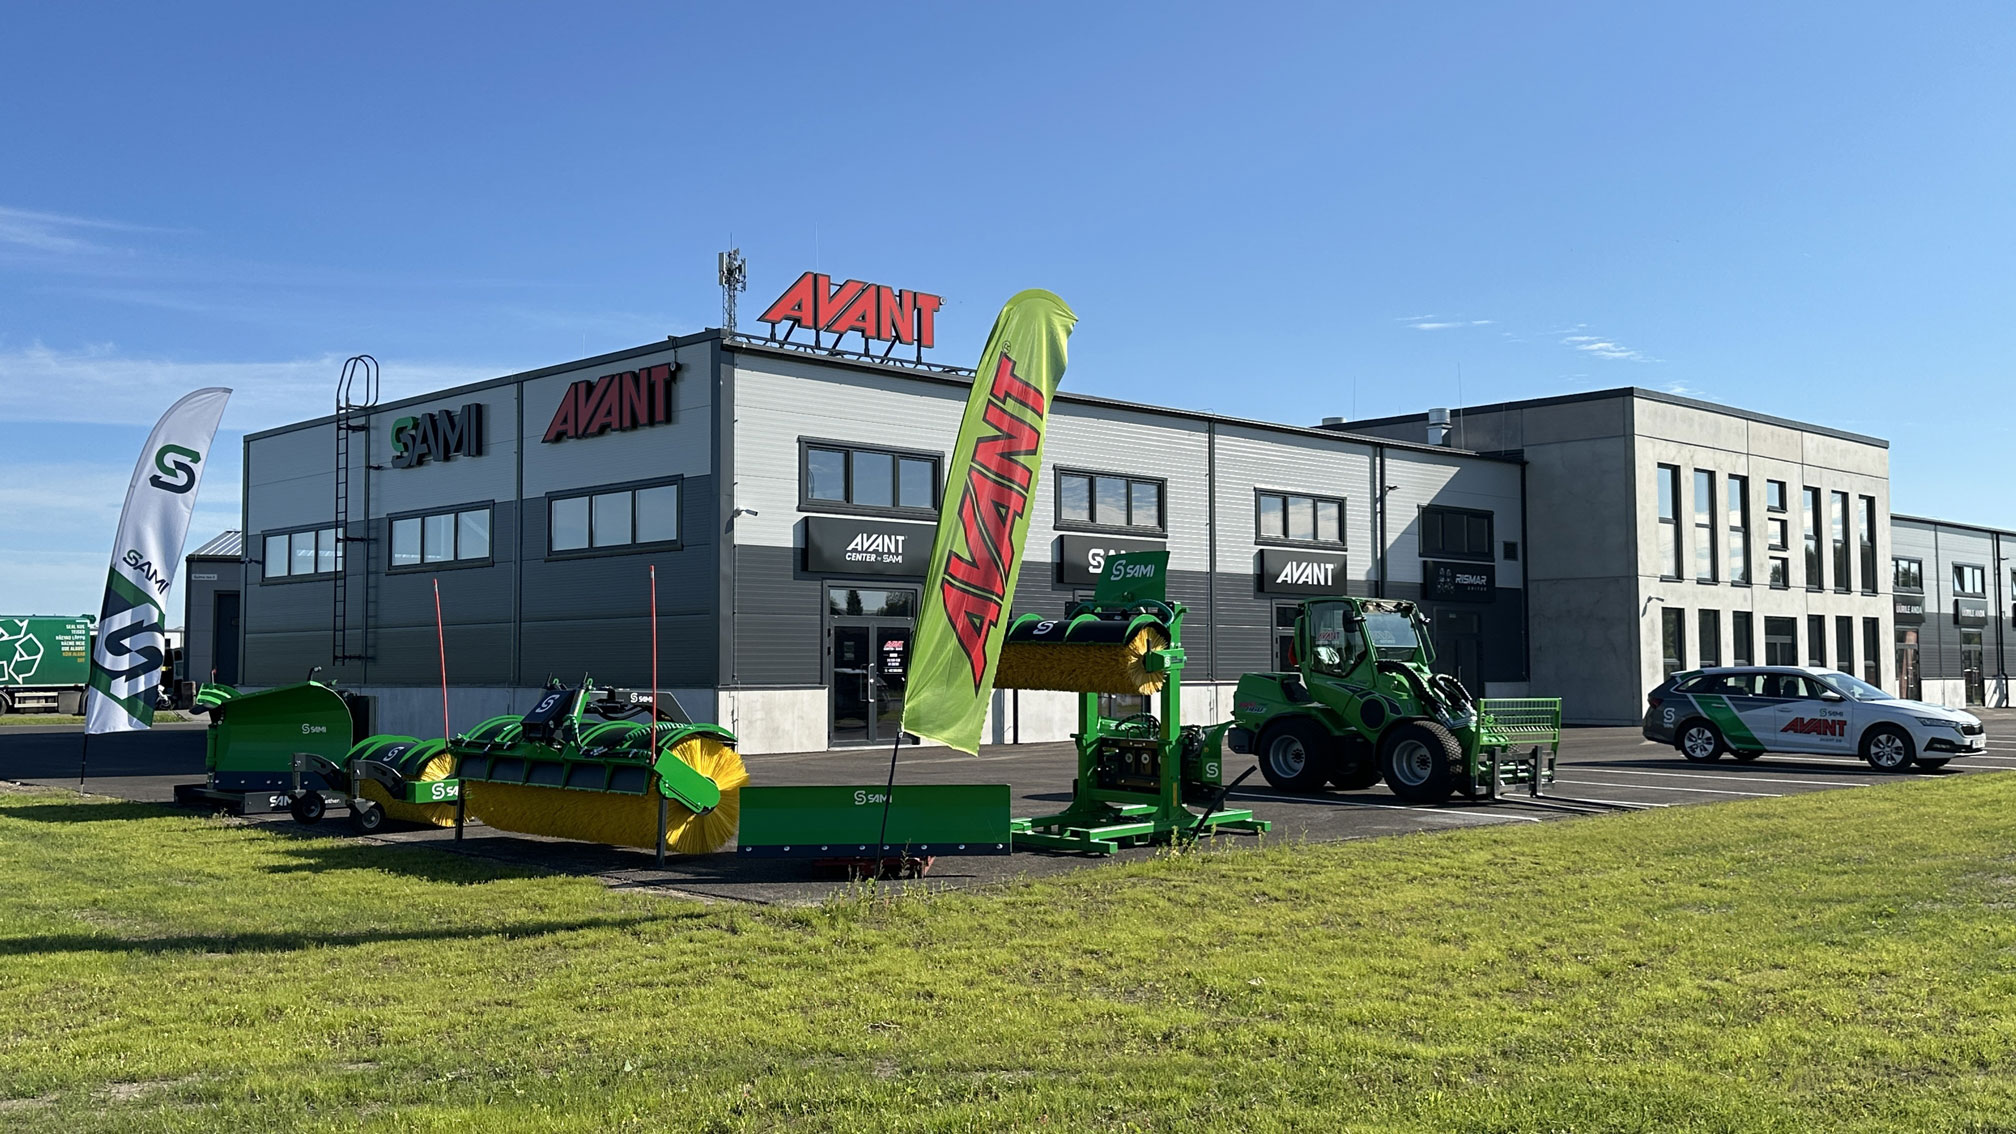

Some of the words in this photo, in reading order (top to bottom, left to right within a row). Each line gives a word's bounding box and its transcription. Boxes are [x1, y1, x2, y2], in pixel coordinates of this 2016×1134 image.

[757, 271, 940, 348] AVANT
[541, 361, 674, 443] AVANT
[391, 403, 483, 469] SAMI
[940, 350, 1045, 698] AVANT
[846, 532, 905, 554] AVANT
[845, 552, 877, 562] CENTER
[882, 554, 903, 564] SAMI
[123, 549, 170, 595] SAMI
[1126, 564, 1155, 578] SAMI
[1275, 560, 1335, 586] AVANT
[1455, 573, 1488, 585] RISMAR
[1779, 716, 1847, 737] AVANT
[269, 795, 293, 808] SAM
[446, 786, 459, 797] SA
[867, 794, 893, 804] SAMI
